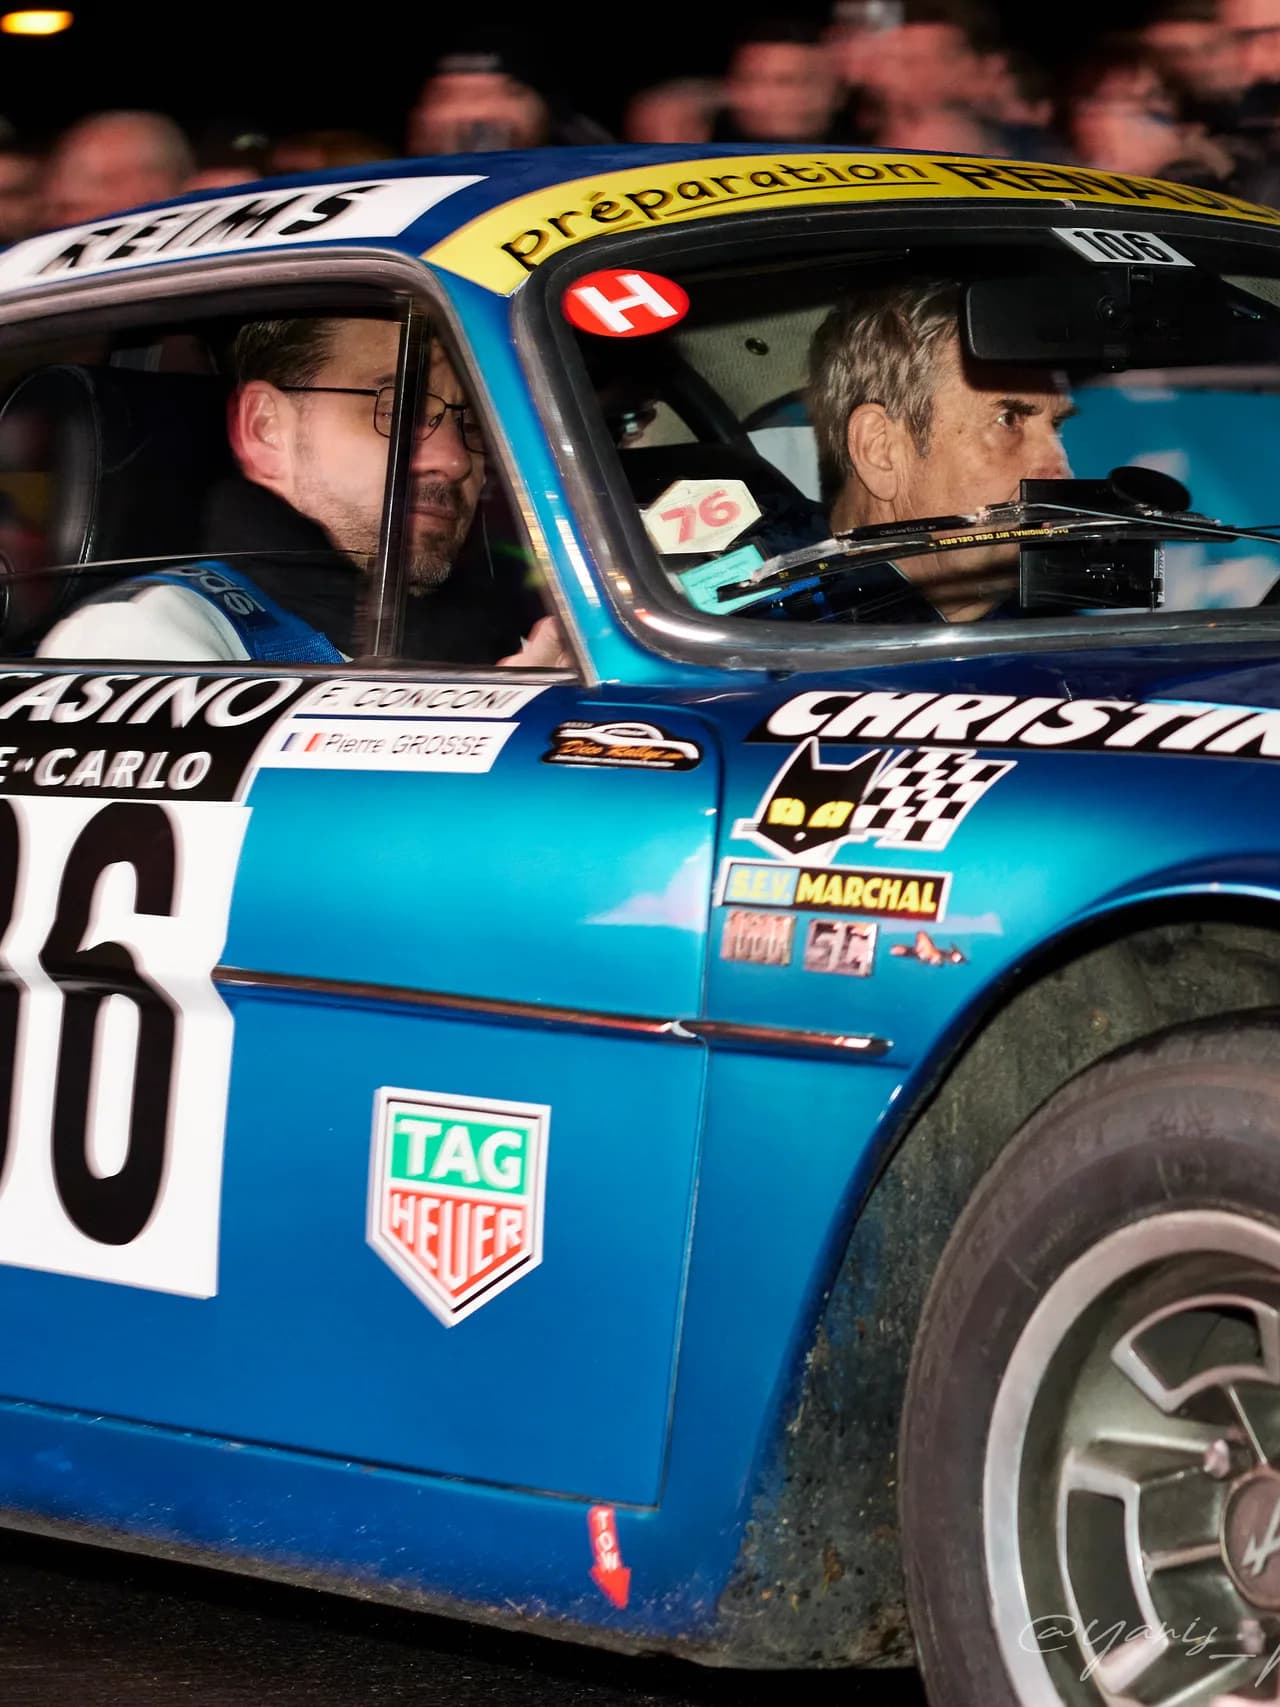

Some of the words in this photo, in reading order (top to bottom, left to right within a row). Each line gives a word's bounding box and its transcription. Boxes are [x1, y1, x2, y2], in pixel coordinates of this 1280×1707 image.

[36, 184, 390, 276] REIMS
[500, 161, 929, 272] préparation
[1073, 231, 1175, 264] 106
[572, 273, 678, 333] H
[659, 488, 743, 544] 76
[975, 533, 994, 541] DEM
[995, 531, 1010, 539] MIT
[939, 535, 974, 546] GELBEN
[353, 687, 524, 709] CONCONI
[325, 732, 386, 753] Pierre
[391, 734, 493, 756] GROSSE
[795, 871, 937, 913] MARCHAL
[396, 1119, 525, 1190] TAG
[387, 1191, 523, 1287] HEUER
